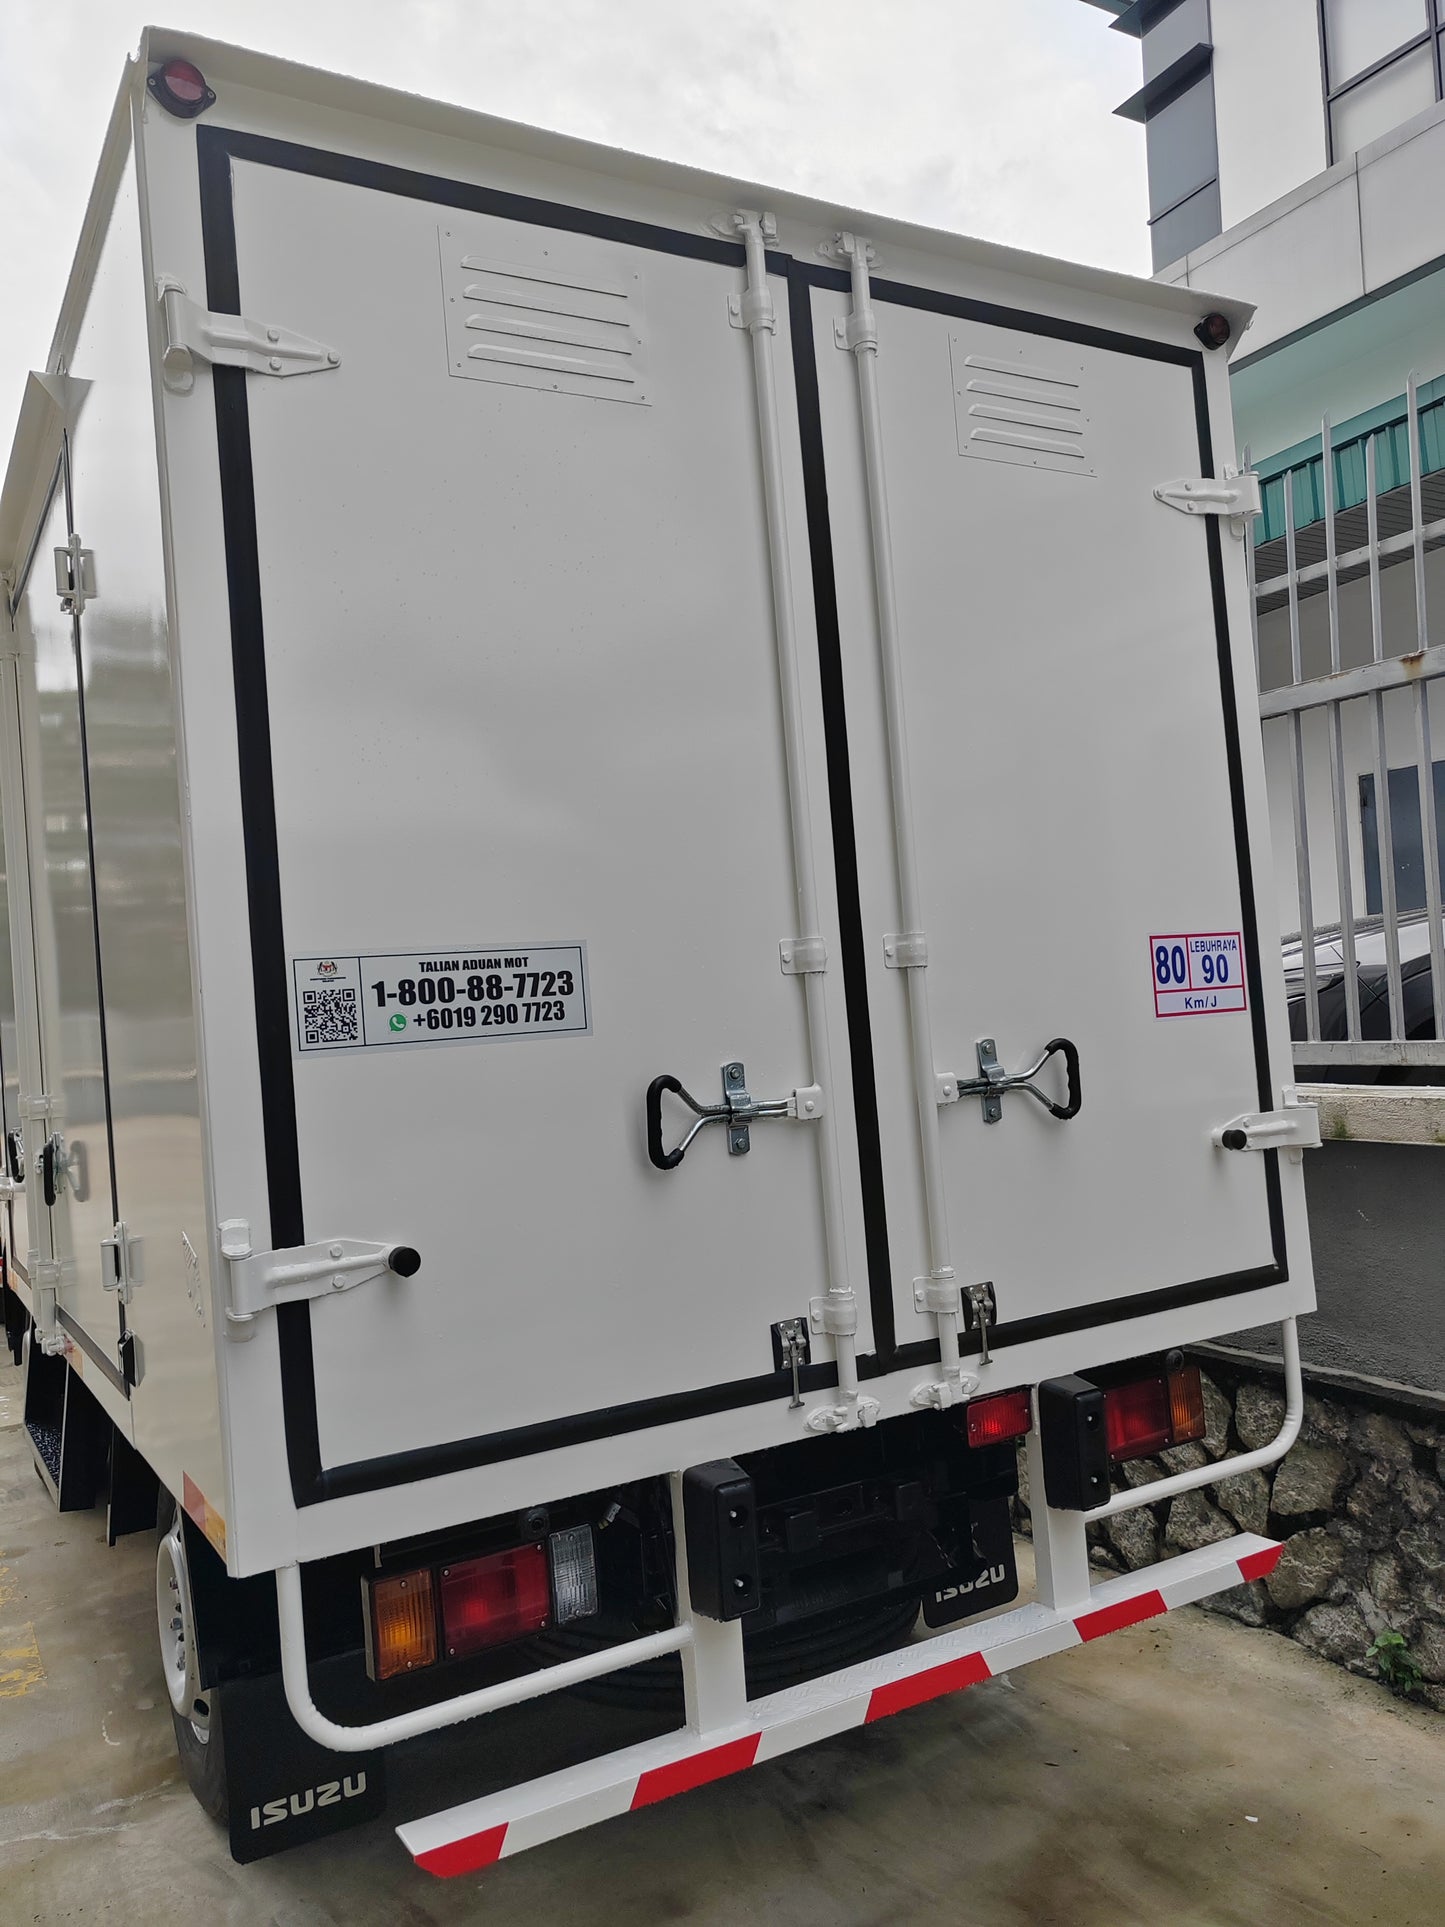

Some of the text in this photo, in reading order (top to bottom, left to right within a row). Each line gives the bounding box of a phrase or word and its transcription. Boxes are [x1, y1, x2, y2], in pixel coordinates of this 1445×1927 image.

[1190, 939, 1237, 953] LEBUHRAYA
[419, 957, 528, 973] TALIAN ADUAN MOT
[1156, 946, 1186, 984] 80
[1201, 954, 1228, 984] 90
[371, 970, 574, 1007] 1-800-88-7723
[413, 1001, 565, 1030] +6019 290 7723
[250, 1771, 367, 1830] ISUZU
